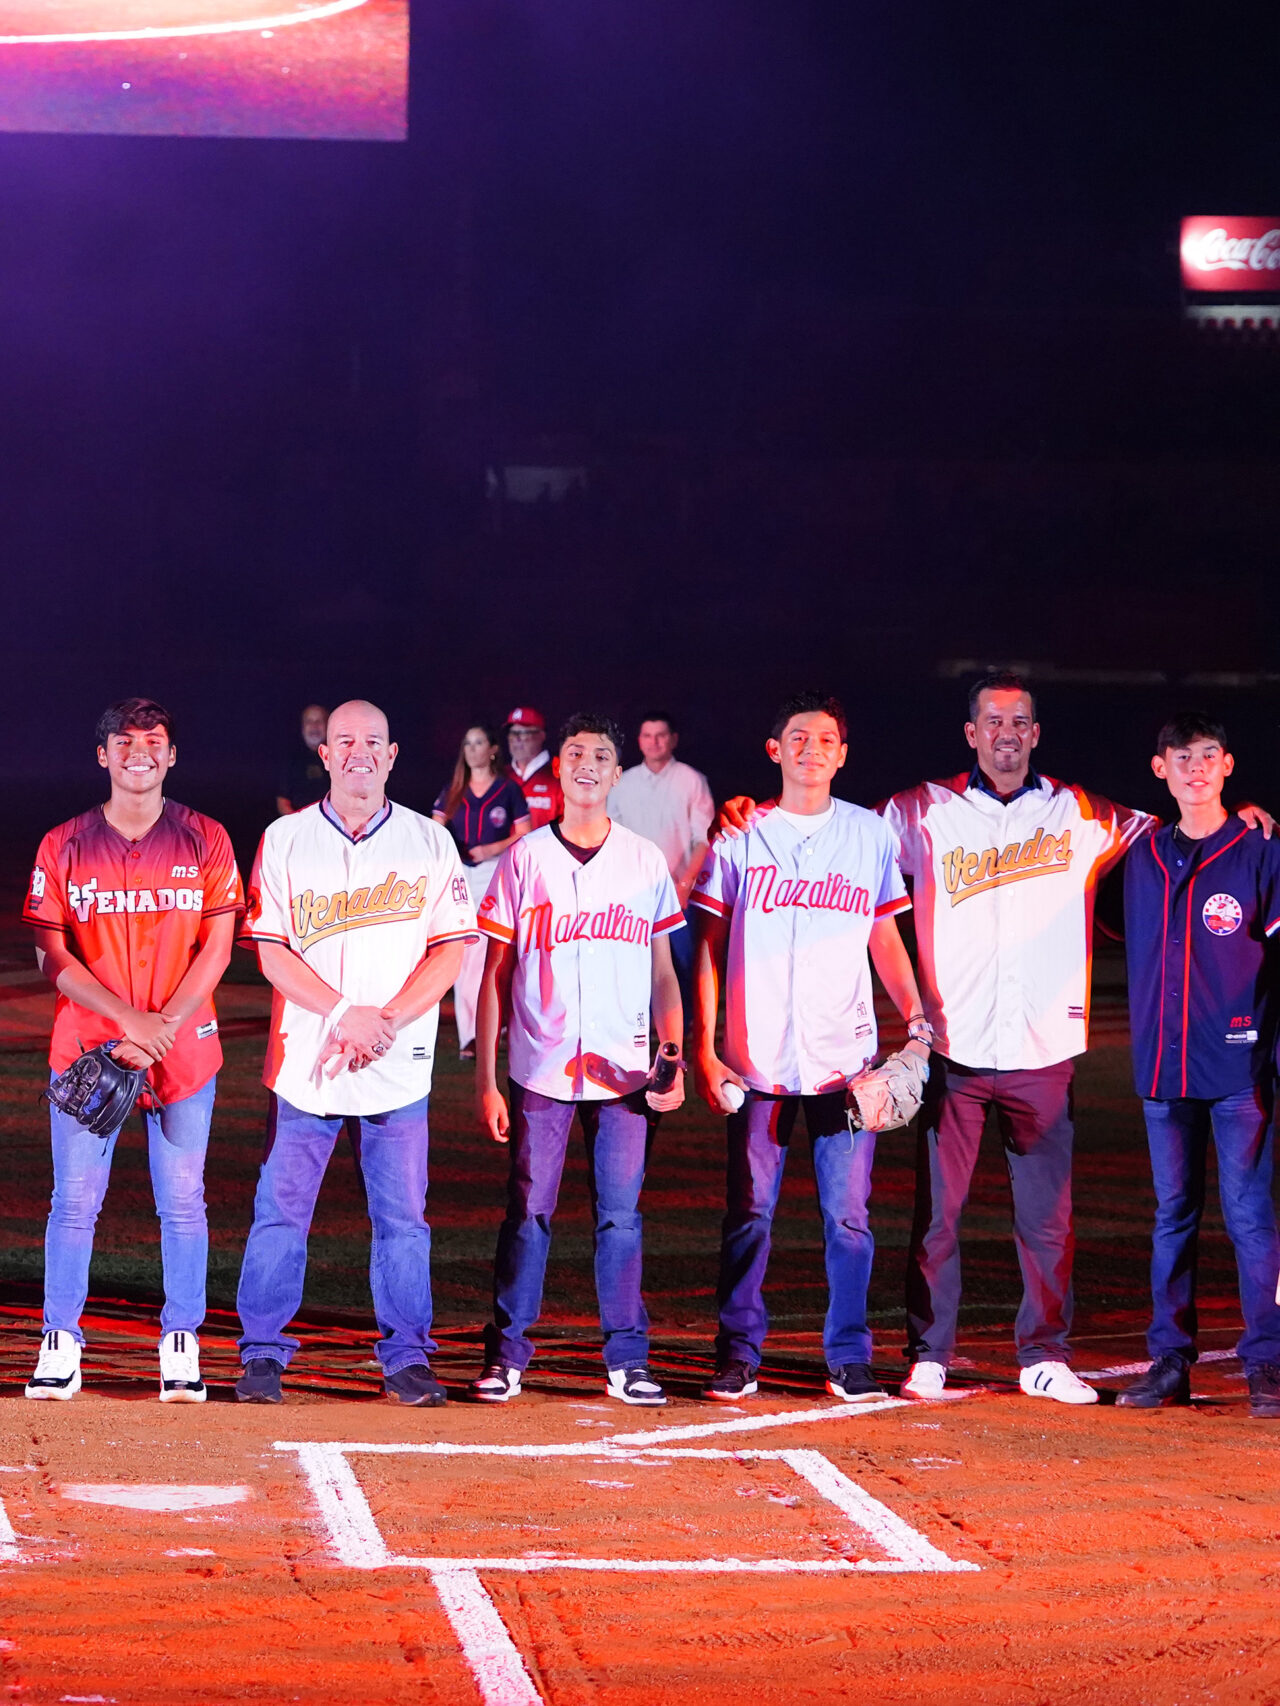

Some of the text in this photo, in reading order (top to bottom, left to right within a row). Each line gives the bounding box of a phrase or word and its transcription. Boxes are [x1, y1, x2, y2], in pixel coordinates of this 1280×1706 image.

[171, 864, 199, 878] ms
[942, 827, 1074, 893] Venados
[290, 871, 428, 939] Venados
[745, 864, 871, 917] Mazatlán
[521, 901, 650, 953] Mazatlán
[1230, 1015, 1252, 1028] ms
